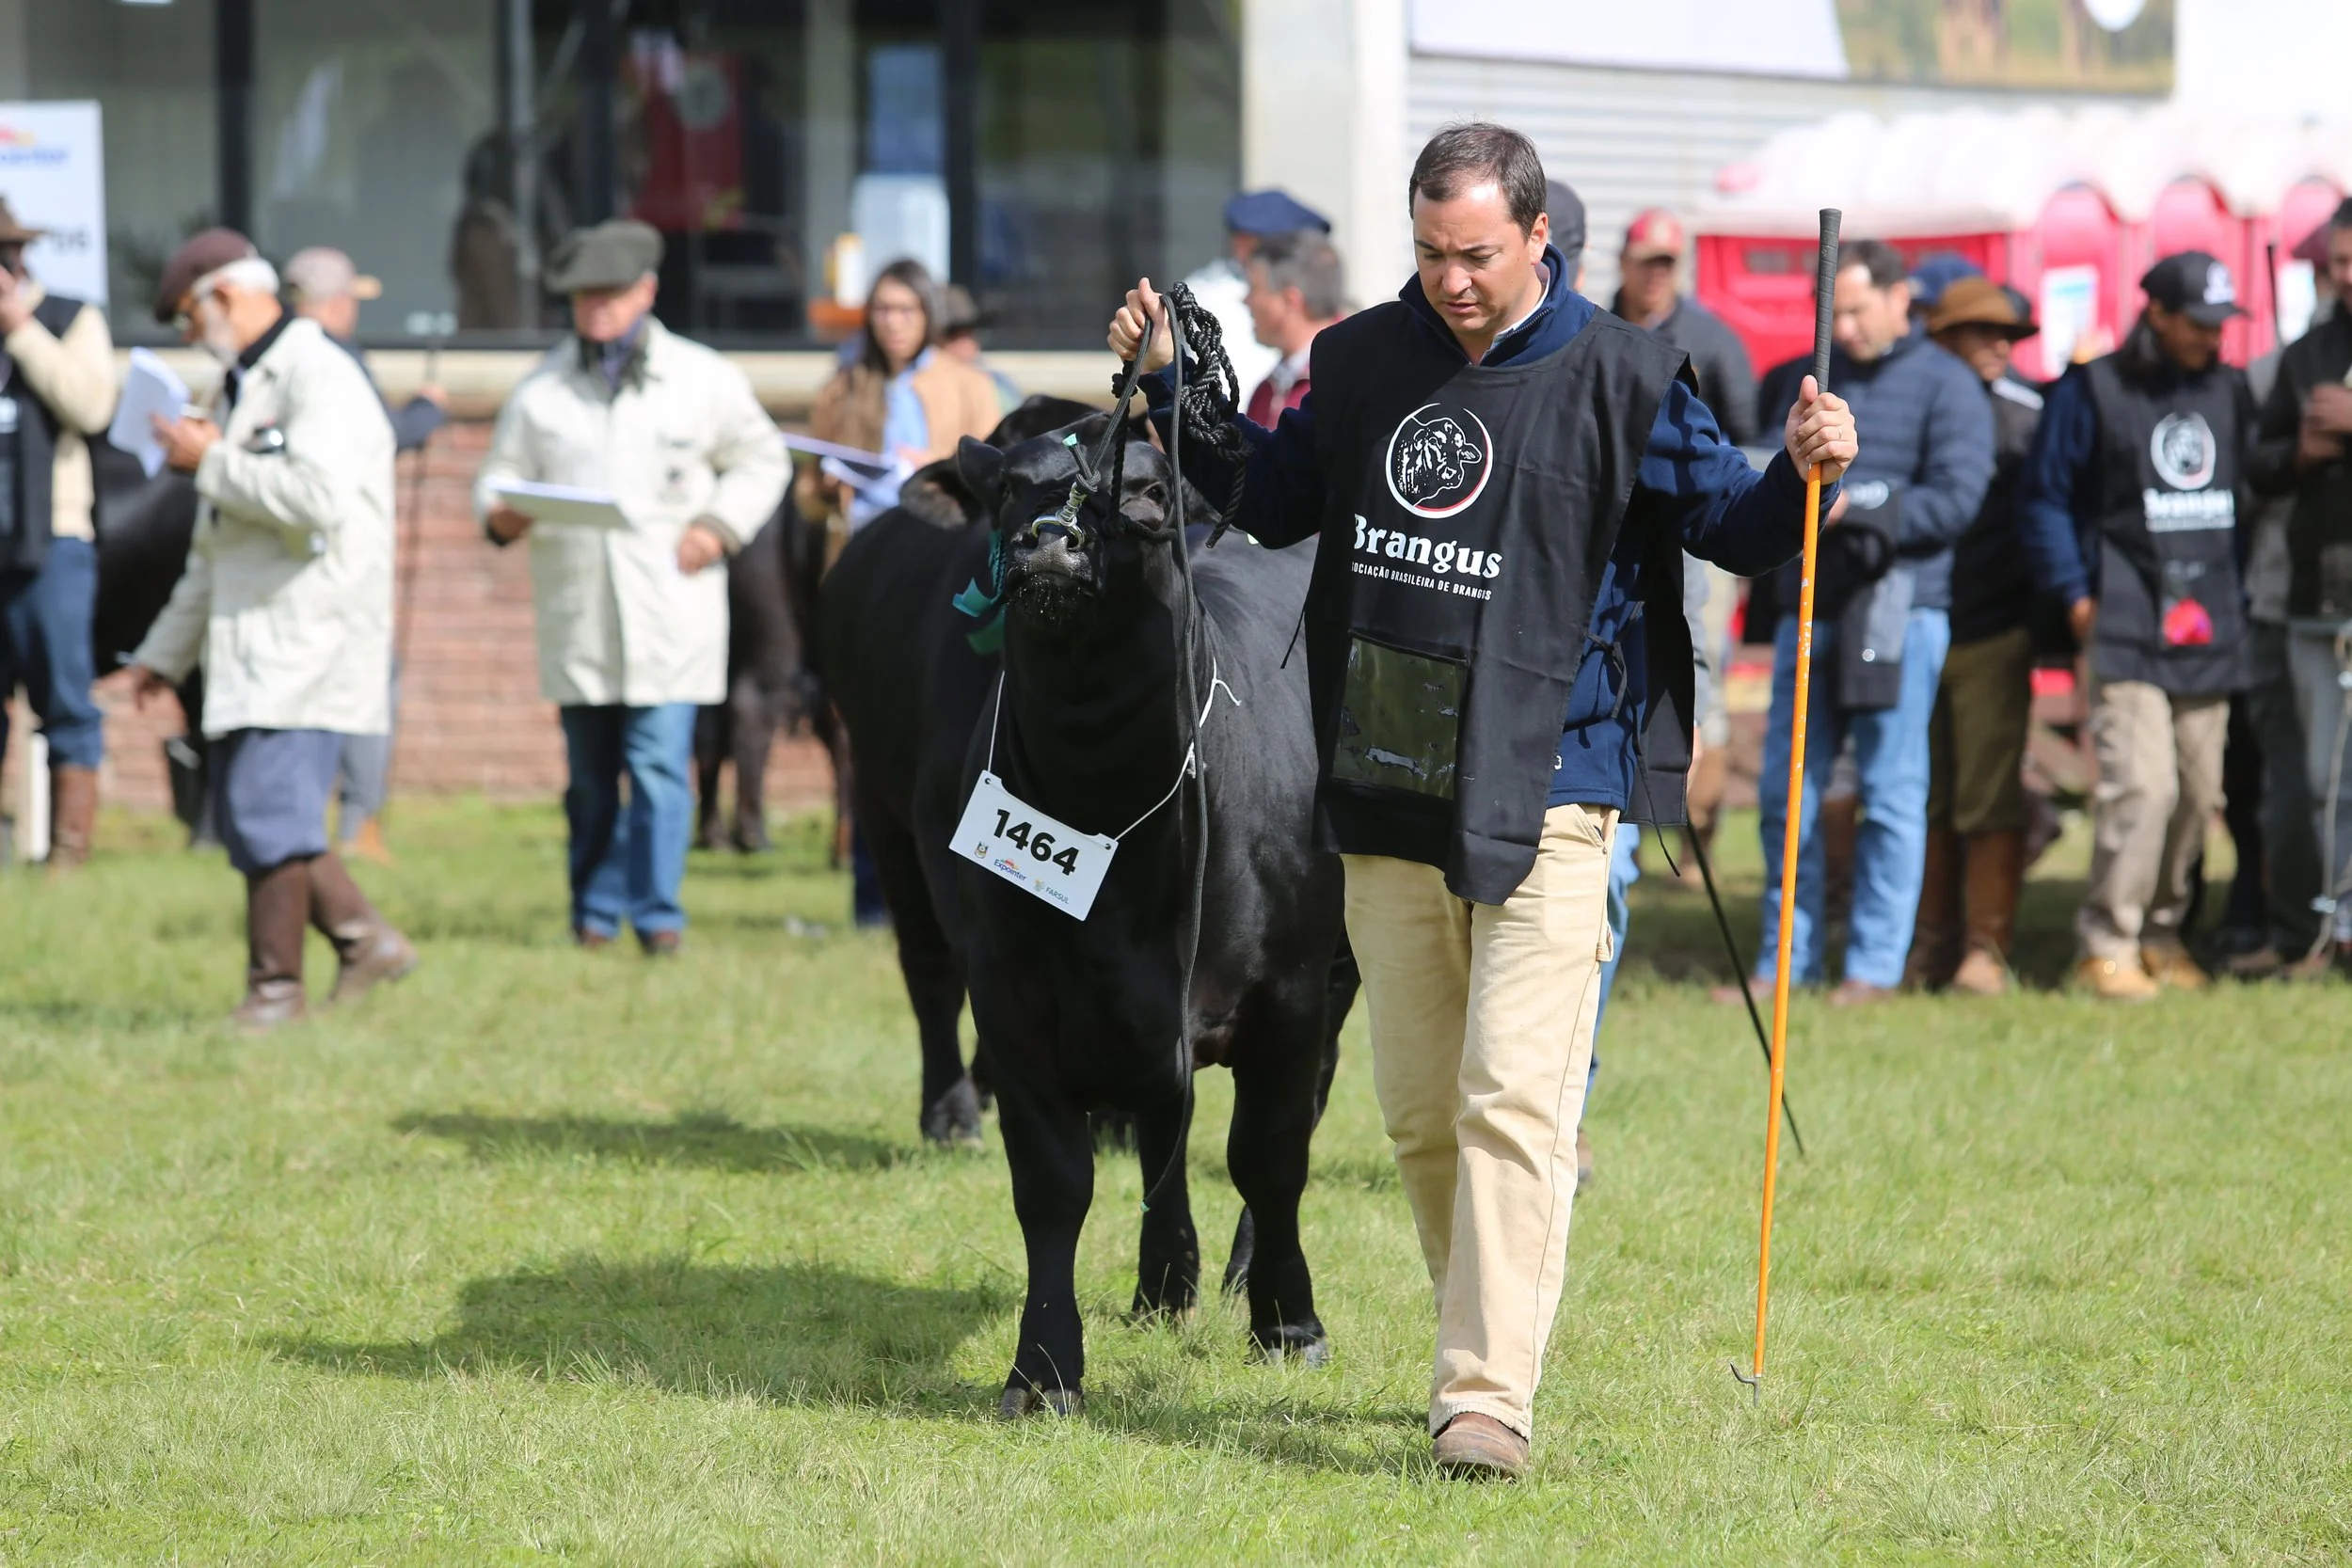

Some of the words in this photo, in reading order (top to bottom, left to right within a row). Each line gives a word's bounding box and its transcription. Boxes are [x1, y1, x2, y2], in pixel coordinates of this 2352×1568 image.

[1391, 570, 1435, 589] BRASILEIRA
[1438, 579, 1450, 593] DE
[993, 809, 1079, 876] 1464
[993, 859, 1026, 881] Expointer
[1045, 887, 1070, 905] FARSUL
